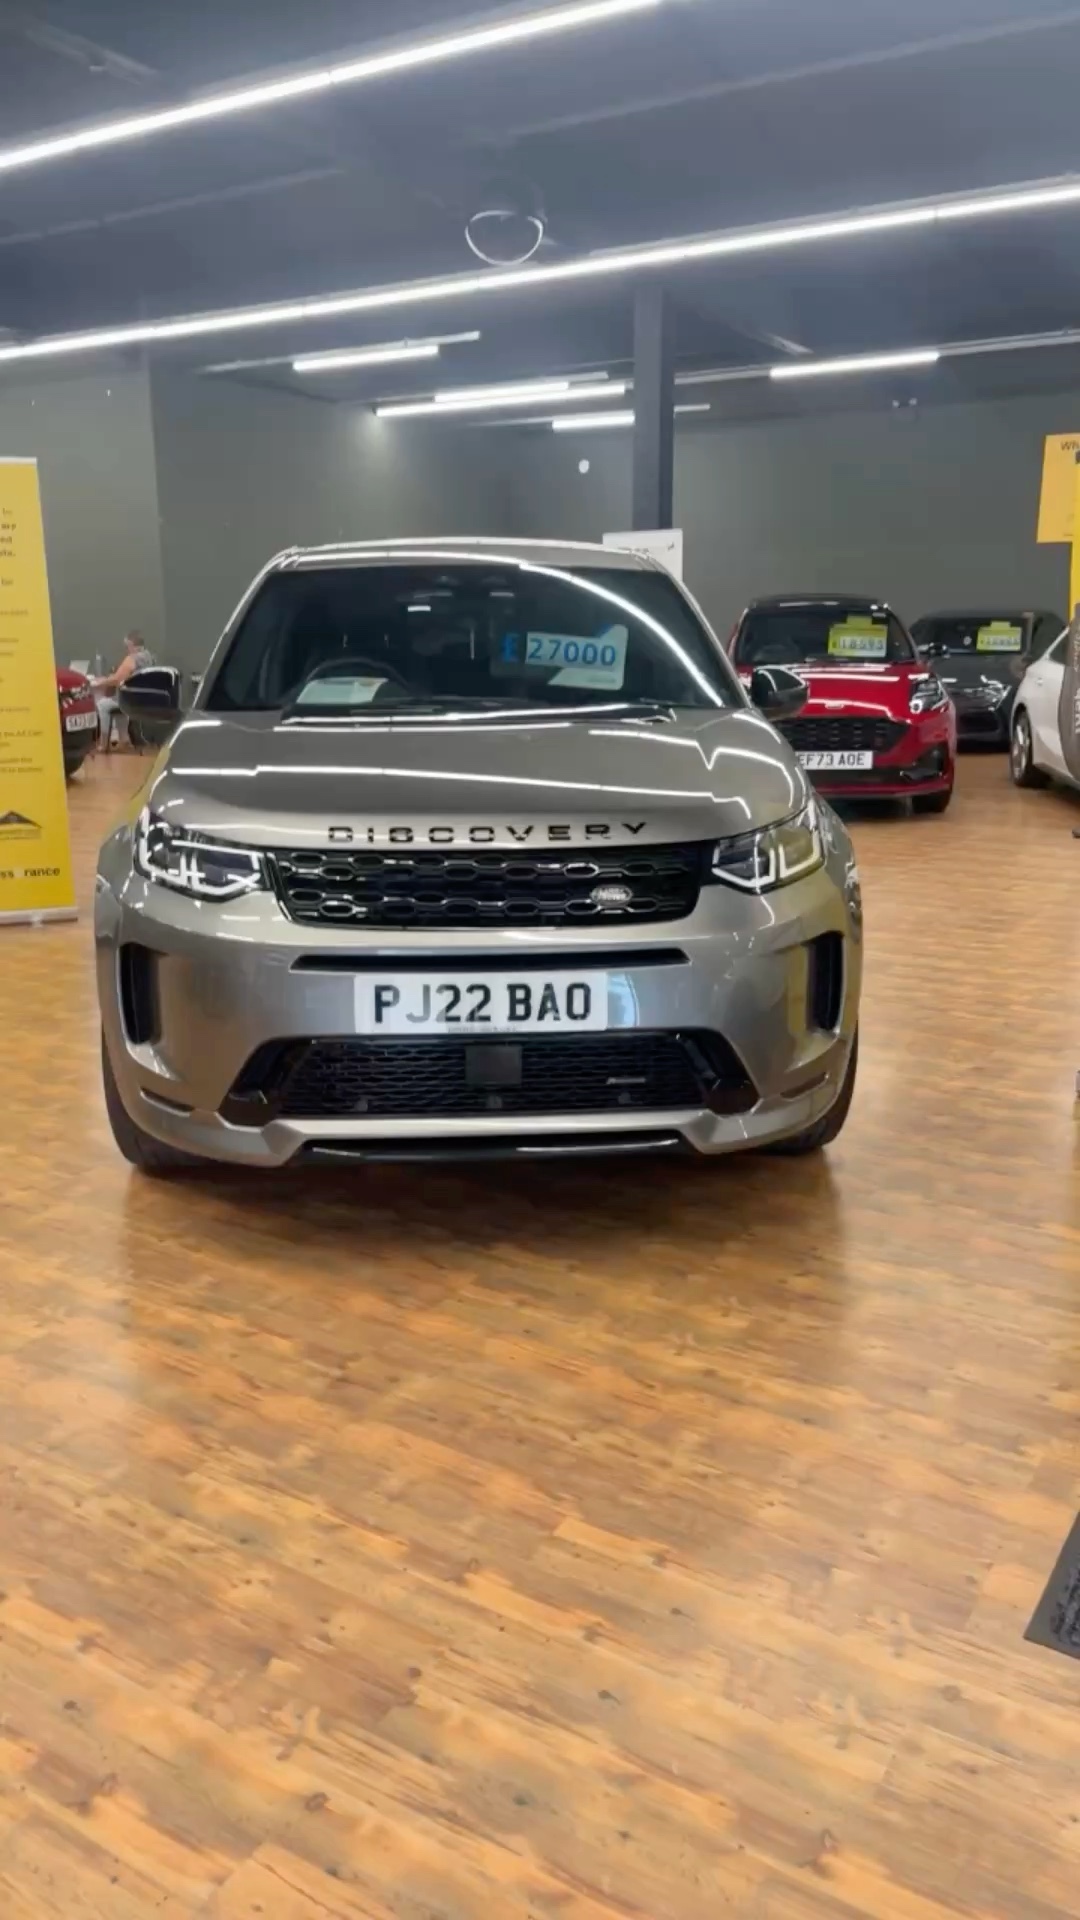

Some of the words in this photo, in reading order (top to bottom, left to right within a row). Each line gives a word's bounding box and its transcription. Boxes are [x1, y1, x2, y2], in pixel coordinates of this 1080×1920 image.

[328, 821, 647, 844] DISCOVERY
[373, 983, 492, 1024] PJ22
[506, 982, 592, 1022] BAO
